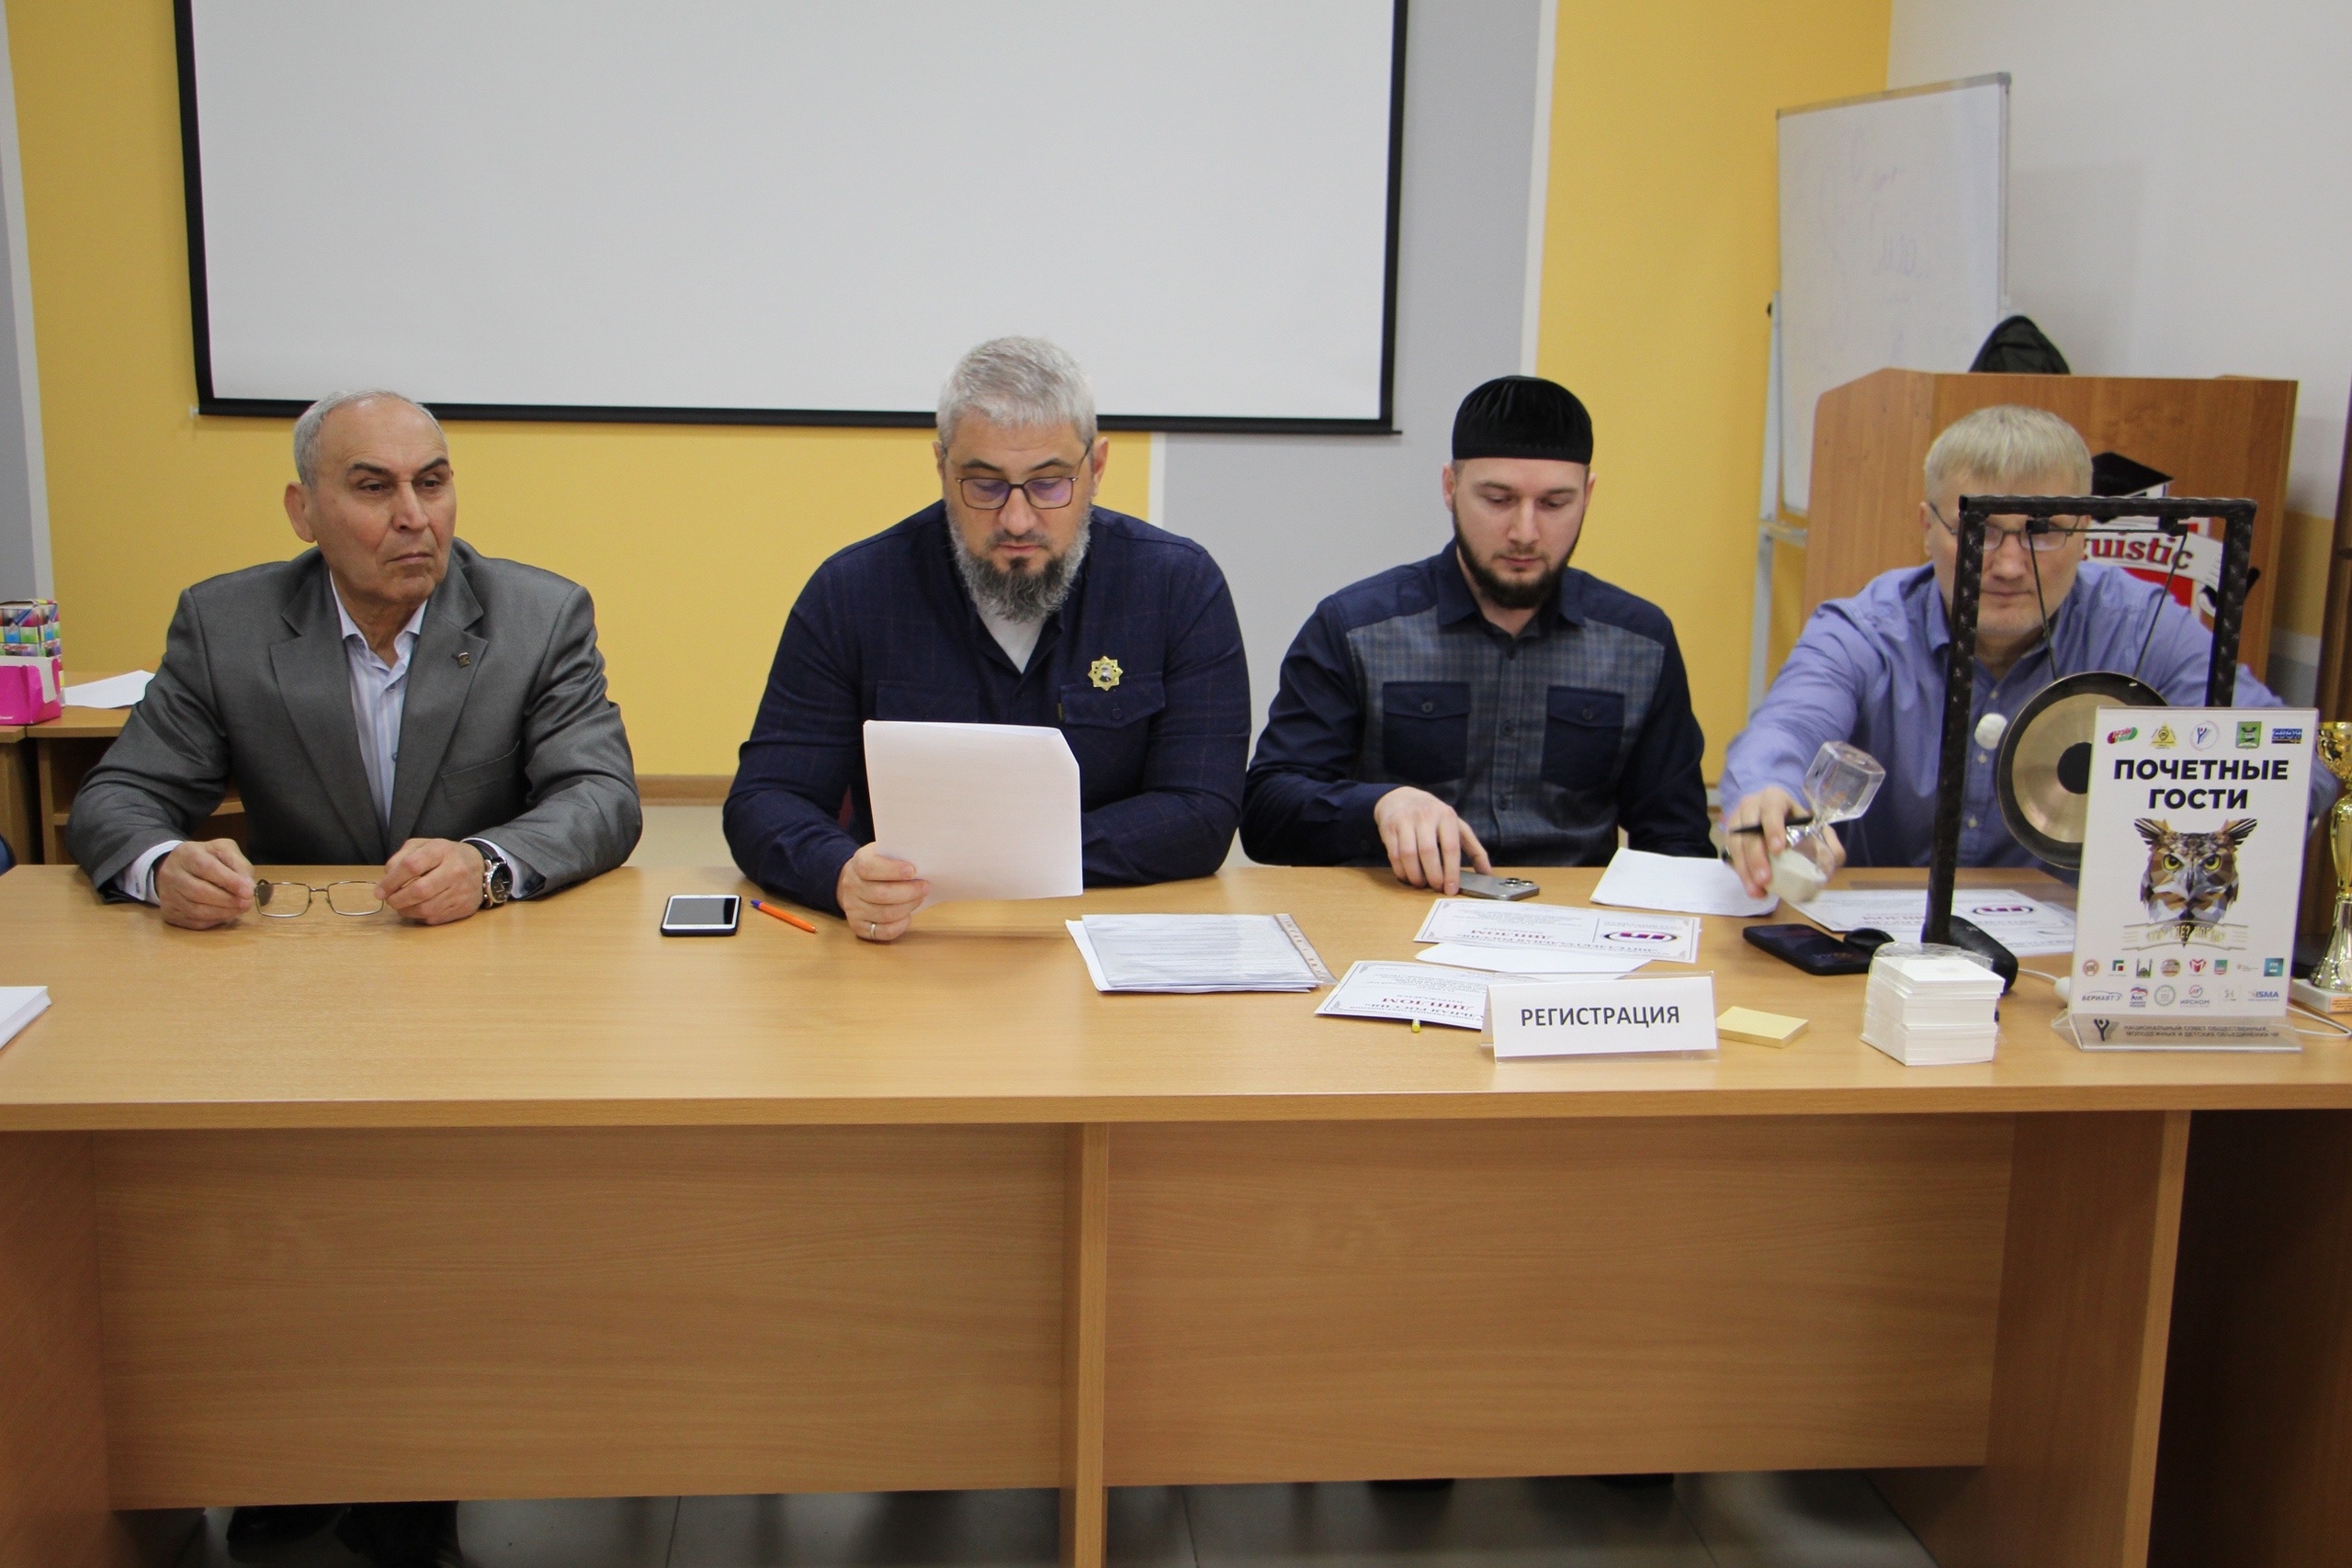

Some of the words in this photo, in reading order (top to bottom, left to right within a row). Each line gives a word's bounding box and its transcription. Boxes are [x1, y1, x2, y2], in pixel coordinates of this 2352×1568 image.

[2080, 532, 2193, 570] uistic
[2113, 759, 2289, 780] ПОЧЕТНЫЕ
[2148, 788, 2248, 809] ГОСТИ
[1382, 998, 1475, 1010] ДИПЛОМ
[1521, 1006, 1679, 1027] РЕГИСТРАЦИЯ
